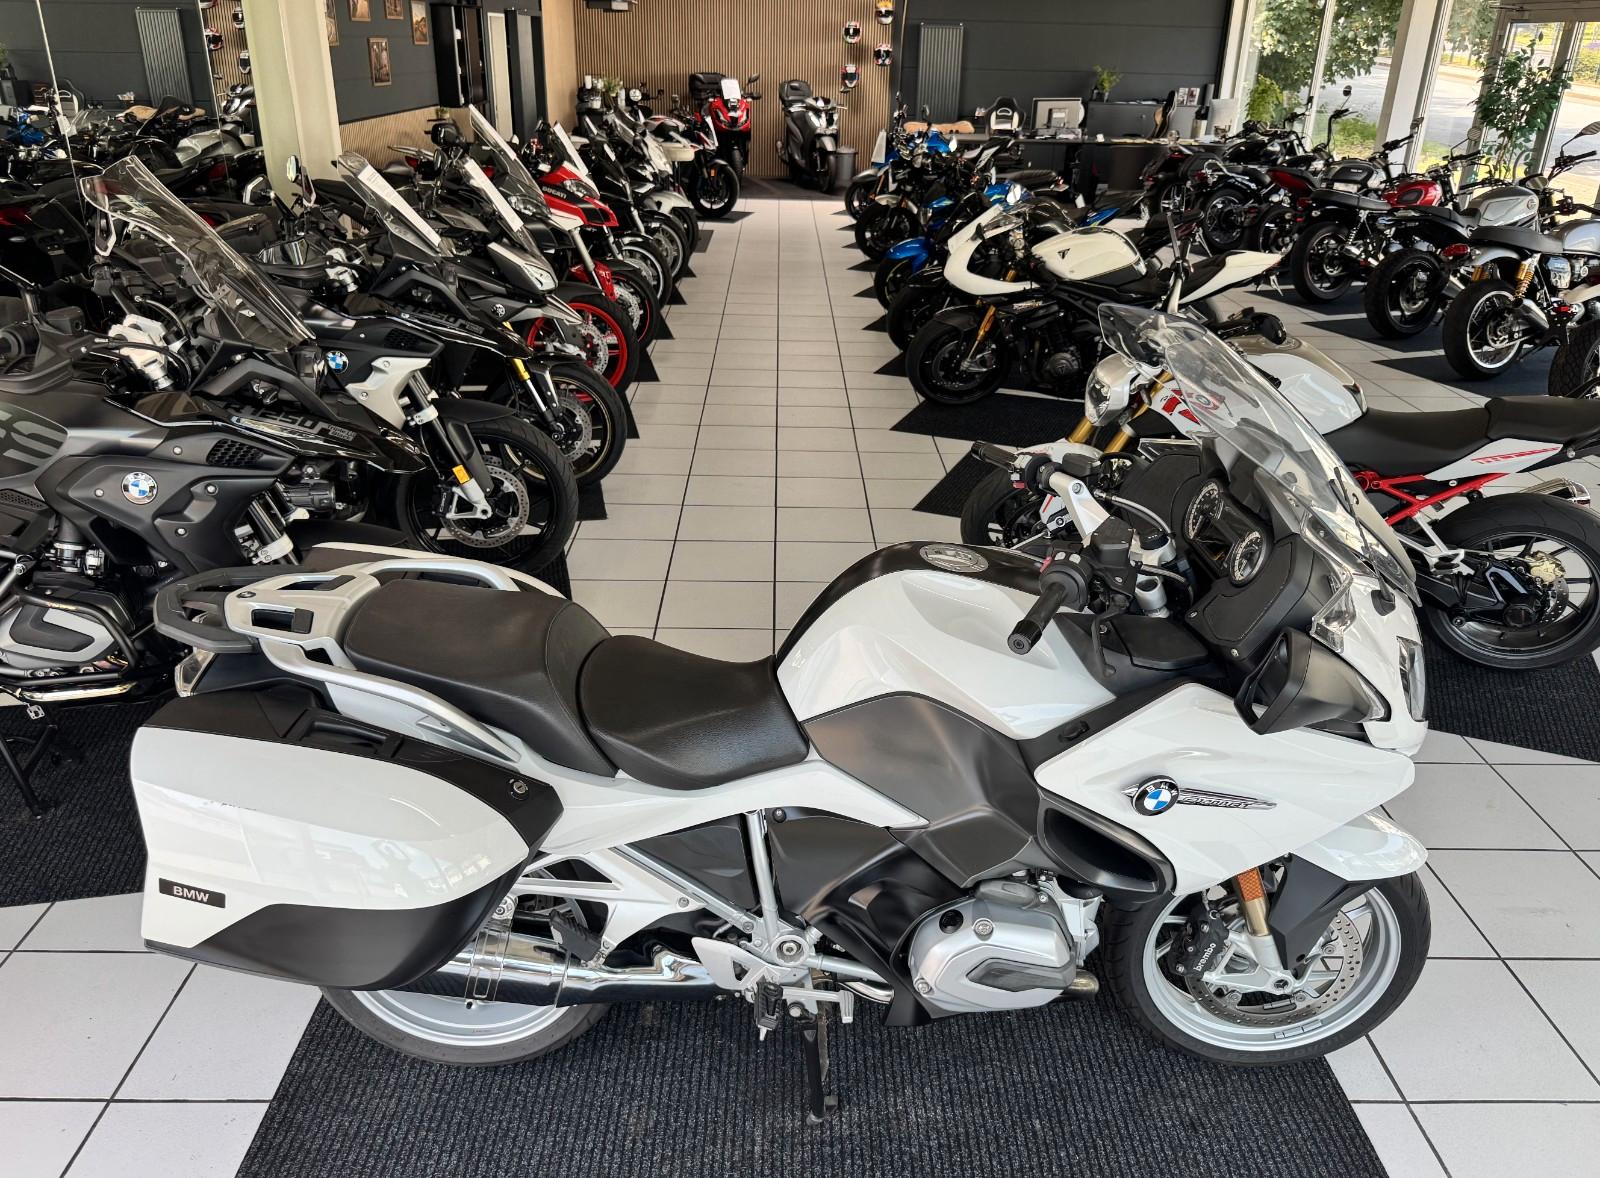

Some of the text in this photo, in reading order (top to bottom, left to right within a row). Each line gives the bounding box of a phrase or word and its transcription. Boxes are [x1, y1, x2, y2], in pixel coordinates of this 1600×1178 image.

[541, 186, 567, 200] DUCATI
[1146, 781, 1179, 797] BMW
[172, 885, 210, 903] BMW
[1192, 942, 1217, 972] brembo
